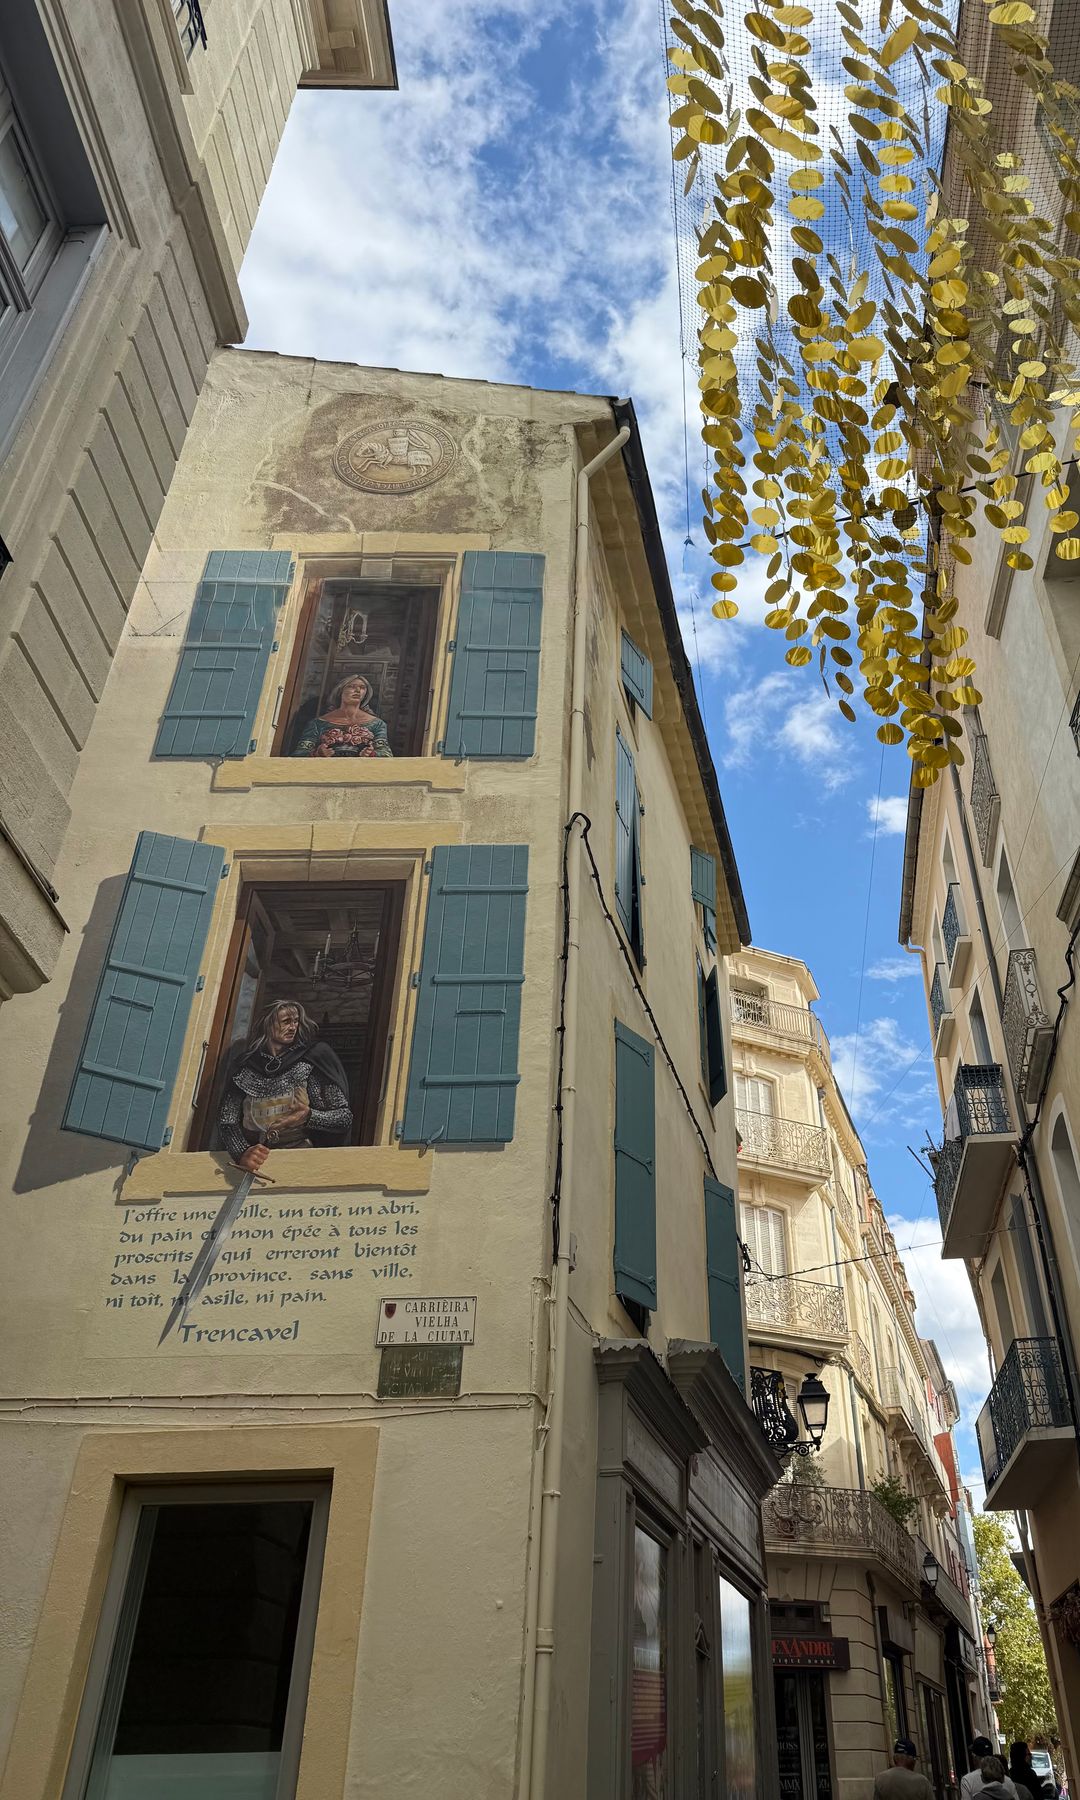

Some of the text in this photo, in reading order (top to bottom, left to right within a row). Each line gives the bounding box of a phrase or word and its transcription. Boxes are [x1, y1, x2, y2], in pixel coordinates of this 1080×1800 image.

[123, 1208, 177, 1225] J'offre
[183, 1210, 217, 1221] une
[279, 1208, 303, 1218] un
[348, 1206, 372, 1216] un
[377, 1200, 420, 1215] abri,
[119, 1221, 418, 1245] du pain et mon épée à tous les
[114, 1242, 417, 1268] proscrits qui erreront bientôt
[110, 1273, 156, 1285] dans
[172, 1269, 190, 1284] la
[310, 1268, 353, 1280] sans
[106, 1294, 124, 1308] ni
[171, 1293, 190, 1307] ni
[201, 1289, 249, 1305] asile,
[256, 1290, 274, 1304] ni
[280, 1289, 327, 1307] pain.
[405, 1300, 469, 1313] CARRIÈIRA
[181, 1319, 300, 1343] Trencavel
[415, 1316, 459, 1327] VIELHA
[381, 1331, 395, 1342] DE
[404, 1331, 417, 1342] LA
